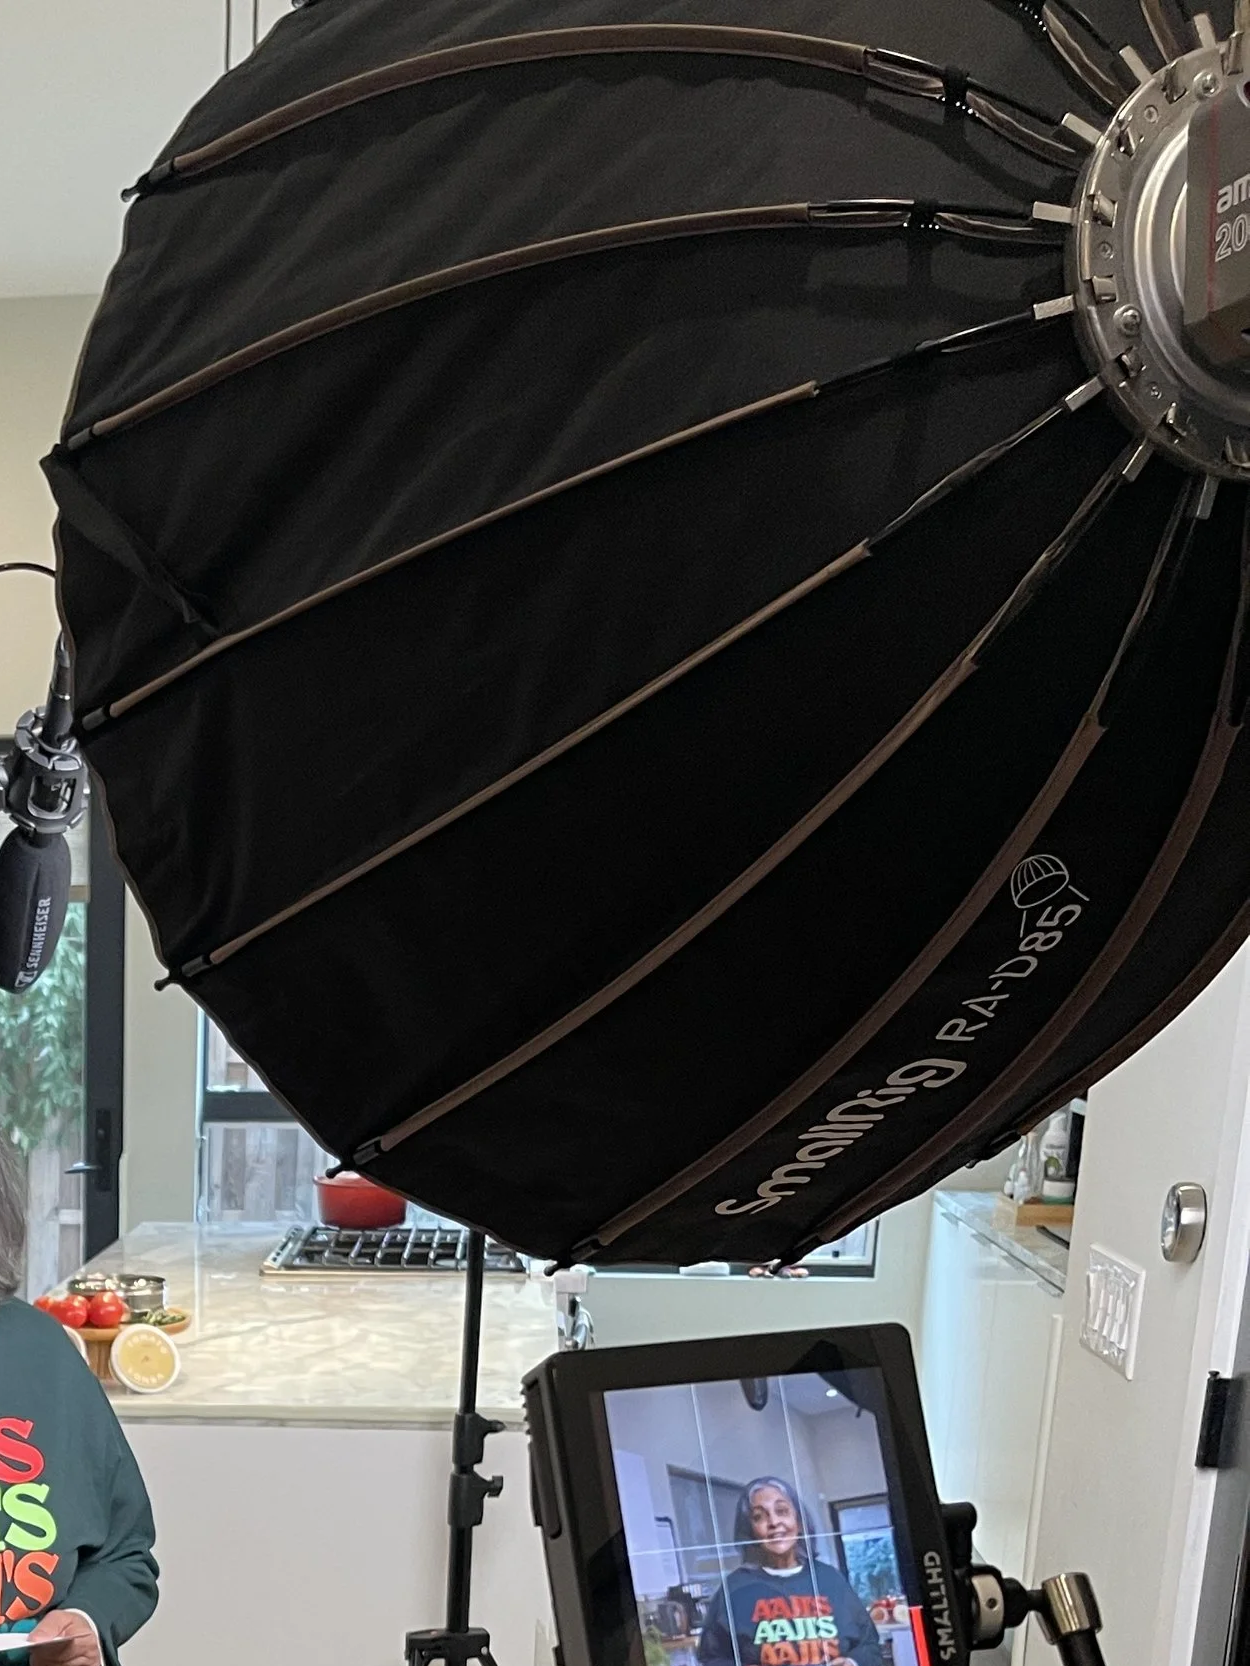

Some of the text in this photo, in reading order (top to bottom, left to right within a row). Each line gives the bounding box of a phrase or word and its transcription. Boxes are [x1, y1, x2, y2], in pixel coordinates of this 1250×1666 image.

[26, 896, 52, 969] SENNHEISER
[936, 903, 1082, 1041] RA-D85
[753, 1615, 838, 1645] AAJI'S
[923, 1551, 957, 1661] SMALLHD
